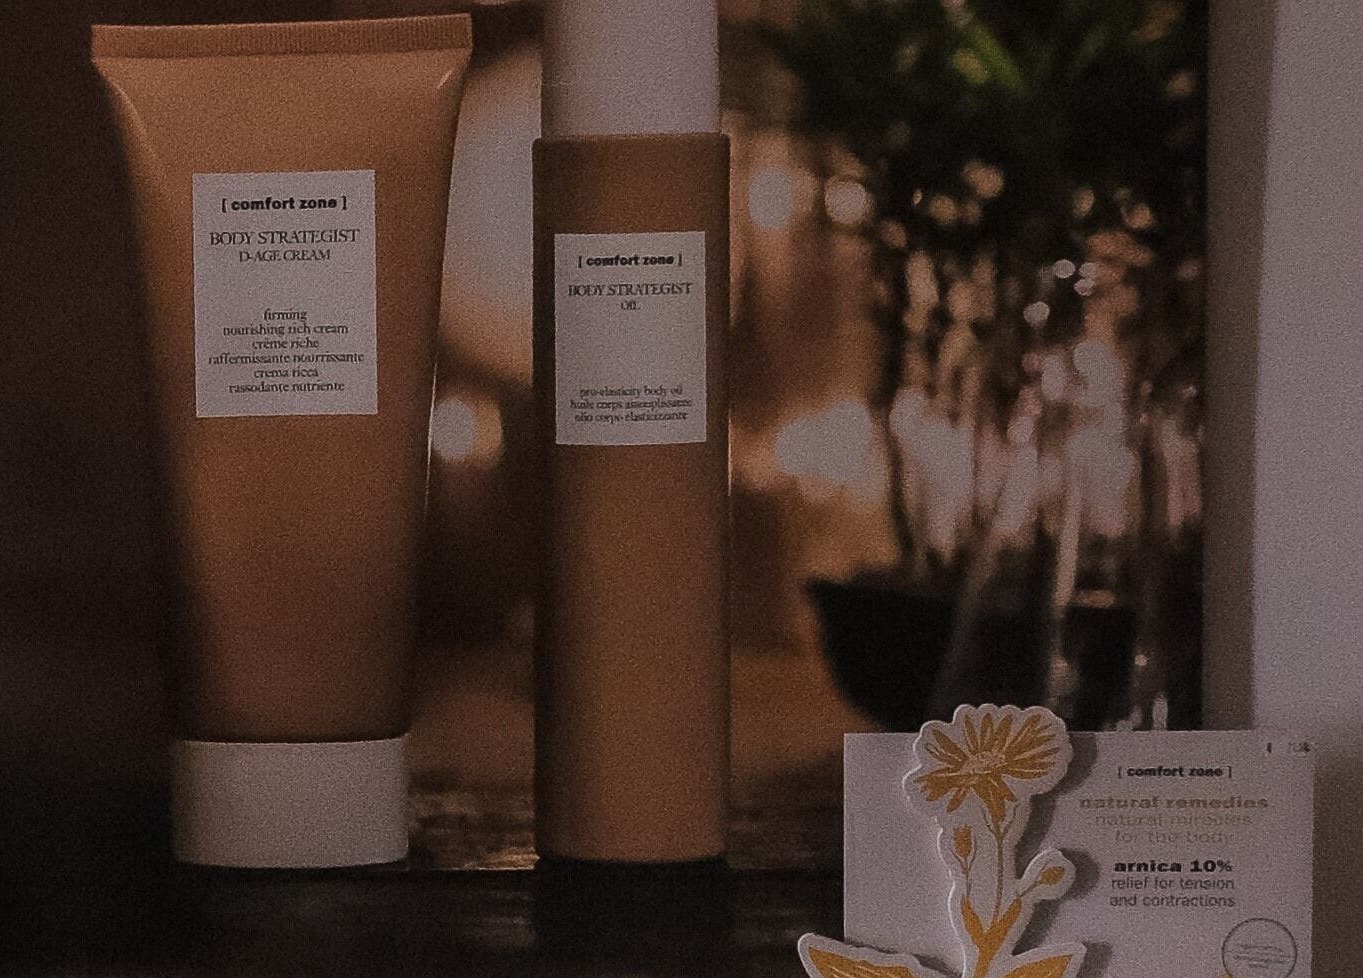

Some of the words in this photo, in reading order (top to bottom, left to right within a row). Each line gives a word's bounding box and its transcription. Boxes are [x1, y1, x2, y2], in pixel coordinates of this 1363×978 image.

[231, 197, 295, 211] comfort
[299, 197, 338, 210] zone
[209, 231, 254, 246] BODY
[257, 228, 361, 245] STRATEGIST
[239, 249, 282, 262] D-AGE
[283, 249, 331, 261] CREAM
[586, 254, 640, 267] comfort
[642, 255, 674, 266] zone
[568, 284, 605, 296] BODY
[606, 282, 693, 296] STRATEGIST
[263, 309, 307, 321] firming
[222, 324, 285, 337] nourishing
[288, 323, 311, 335] rich
[313, 325, 349, 335] cream
[290, 338, 319, 349] riche
[208, 351, 289, 364] raffermissante
[292, 351, 364, 363] nourrissante
[253, 368, 289, 379] crema
[291, 366, 319, 378] ricca
[228, 381, 289, 394] rassodante
[292, 381, 345, 393] nutriente
[644, 384, 667, 397] body
[1126, 766, 1184, 778] comfort
[1188, 767, 1223, 778] zone
[1079, 796, 1159, 809] natural
[1166, 796, 1270, 809] remedies
[1114, 860, 1182, 873] arnica
[1190, 860, 1233, 873] 10%
[1111, 877, 1150, 890] relief
[1154, 877, 1173, 889] for
[1180, 877, 1235, 890] tension
[1110, 894, 1137, 907] and
[1142, 894, 1236, 907] contractions
